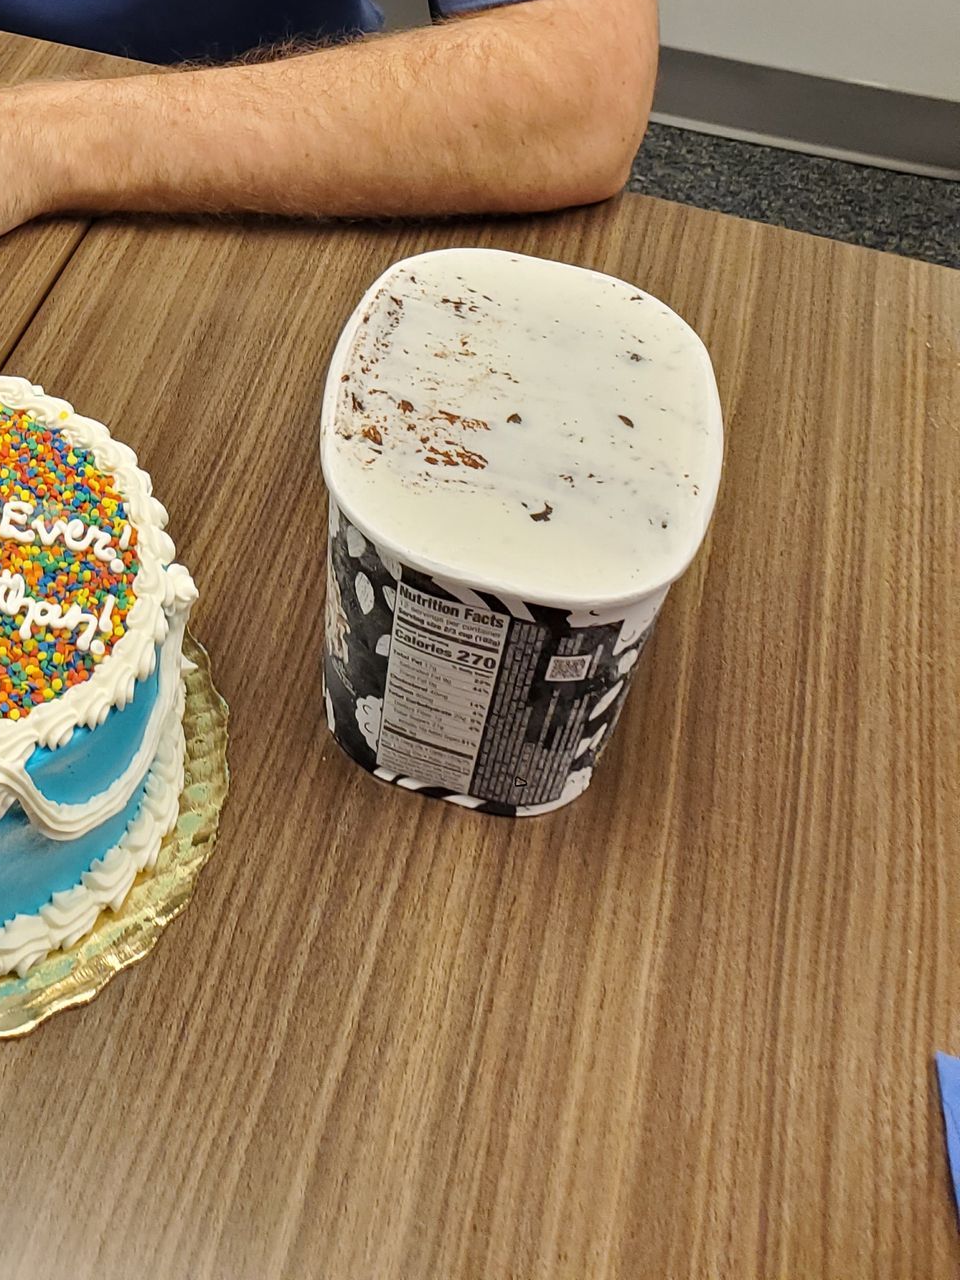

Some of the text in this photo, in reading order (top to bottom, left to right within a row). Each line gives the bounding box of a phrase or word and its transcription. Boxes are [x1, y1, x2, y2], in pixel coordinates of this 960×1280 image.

[0, 501, 132, 574] Ever!
[399, 584, 504, 629] Nutrition Facts
[395, 628, 453, 658] Calories
[456, 649, 497, 670] 270
